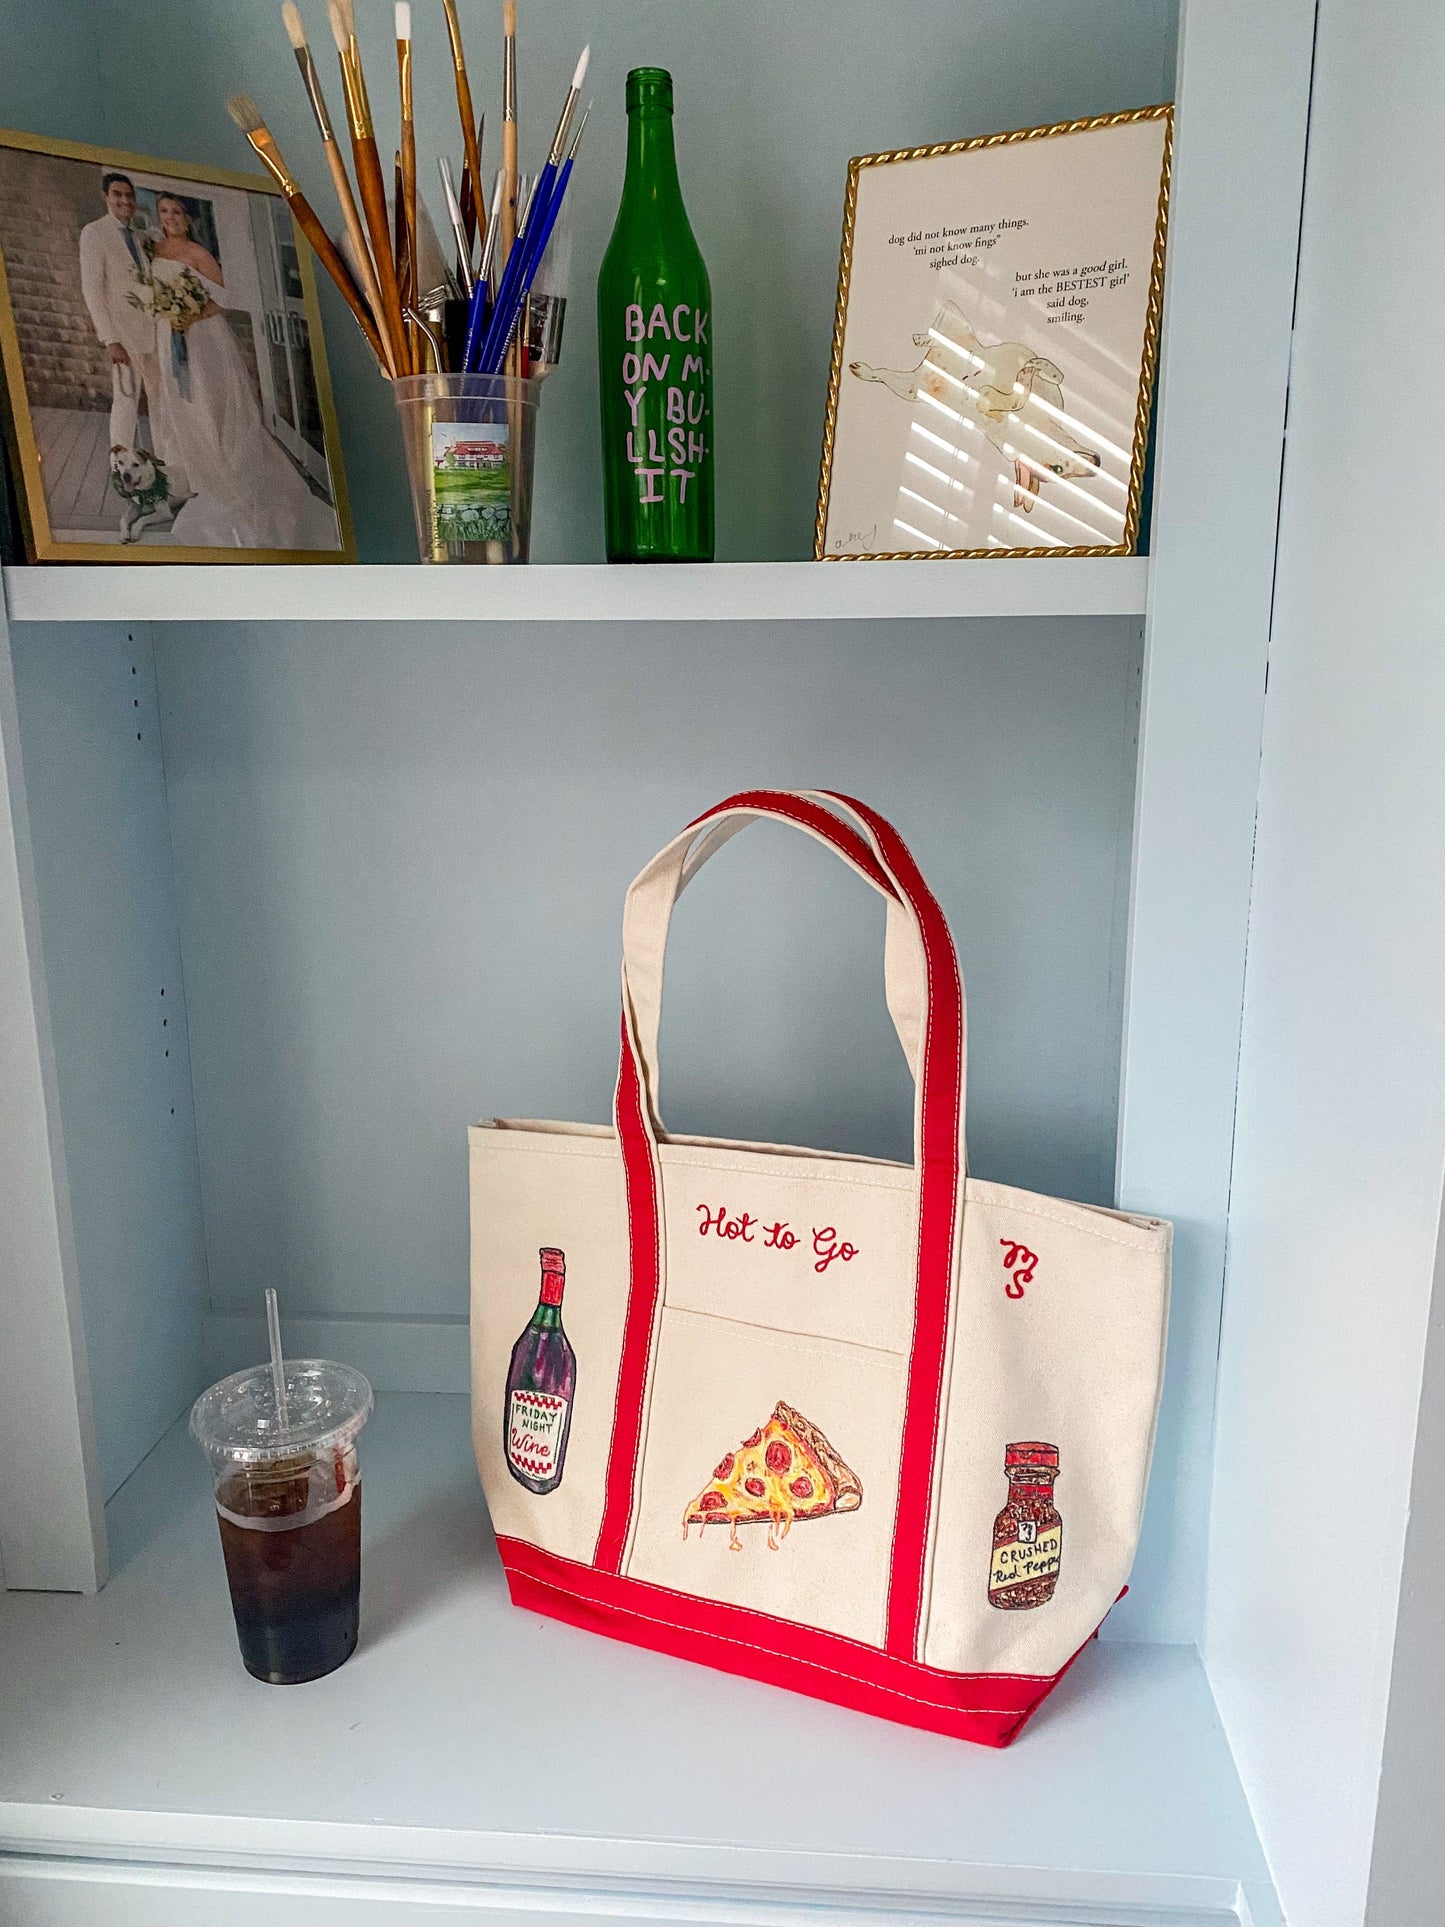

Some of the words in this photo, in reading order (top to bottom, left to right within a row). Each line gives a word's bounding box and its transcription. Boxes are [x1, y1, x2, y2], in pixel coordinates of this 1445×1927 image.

[888, 234, 906, 246] dog
[907, 231, 922, 242] did
[924, 231, 941, 240] not
[942, 227, 967, 238] know
[970, 223, 996, 234] many
[998, 218, 1030, 230] things.
[929, 244, 945, 254] not
[947, 241, 973, 252] know
[929, 255, 959, 270] sighed
[960, 254, 980, 266] dog.
[1015, 271, 1032, 282] but
[1033, 269, 1050, 280] she
[1052, 268, 1070, 278] was
[1080, 261, 1107, 278] good
[1108, 258, 1128, 274] girl.
[1020, 288, 1035, 297] am
[1038, 283, 1054, 295] the
[1055, 276, 1108, 293] BESTEST
[1046, 296, 1066, 309] said
[625, 303, 708, 345] BACK
[1046, 311, 1085, 324] smiling.
[622, 352, 671, 385] ON
[623, 386, 647, 427] Y
[634, 468, 696, 504] IT
[696, 1204, 758, 1242] Hot
[762, 1222, 801, 1249] to
[812, 1226, 860, 1273] Go
[515, 1404, 558, 1423] FRIDAY
[522, 1419, 553, 1434] NIGHT
[511, 1428, 551, 1457] Wine
[1000, 1538, 1058, 1564] CRUSHED
[993, 1564, 1022, 1583] Red
